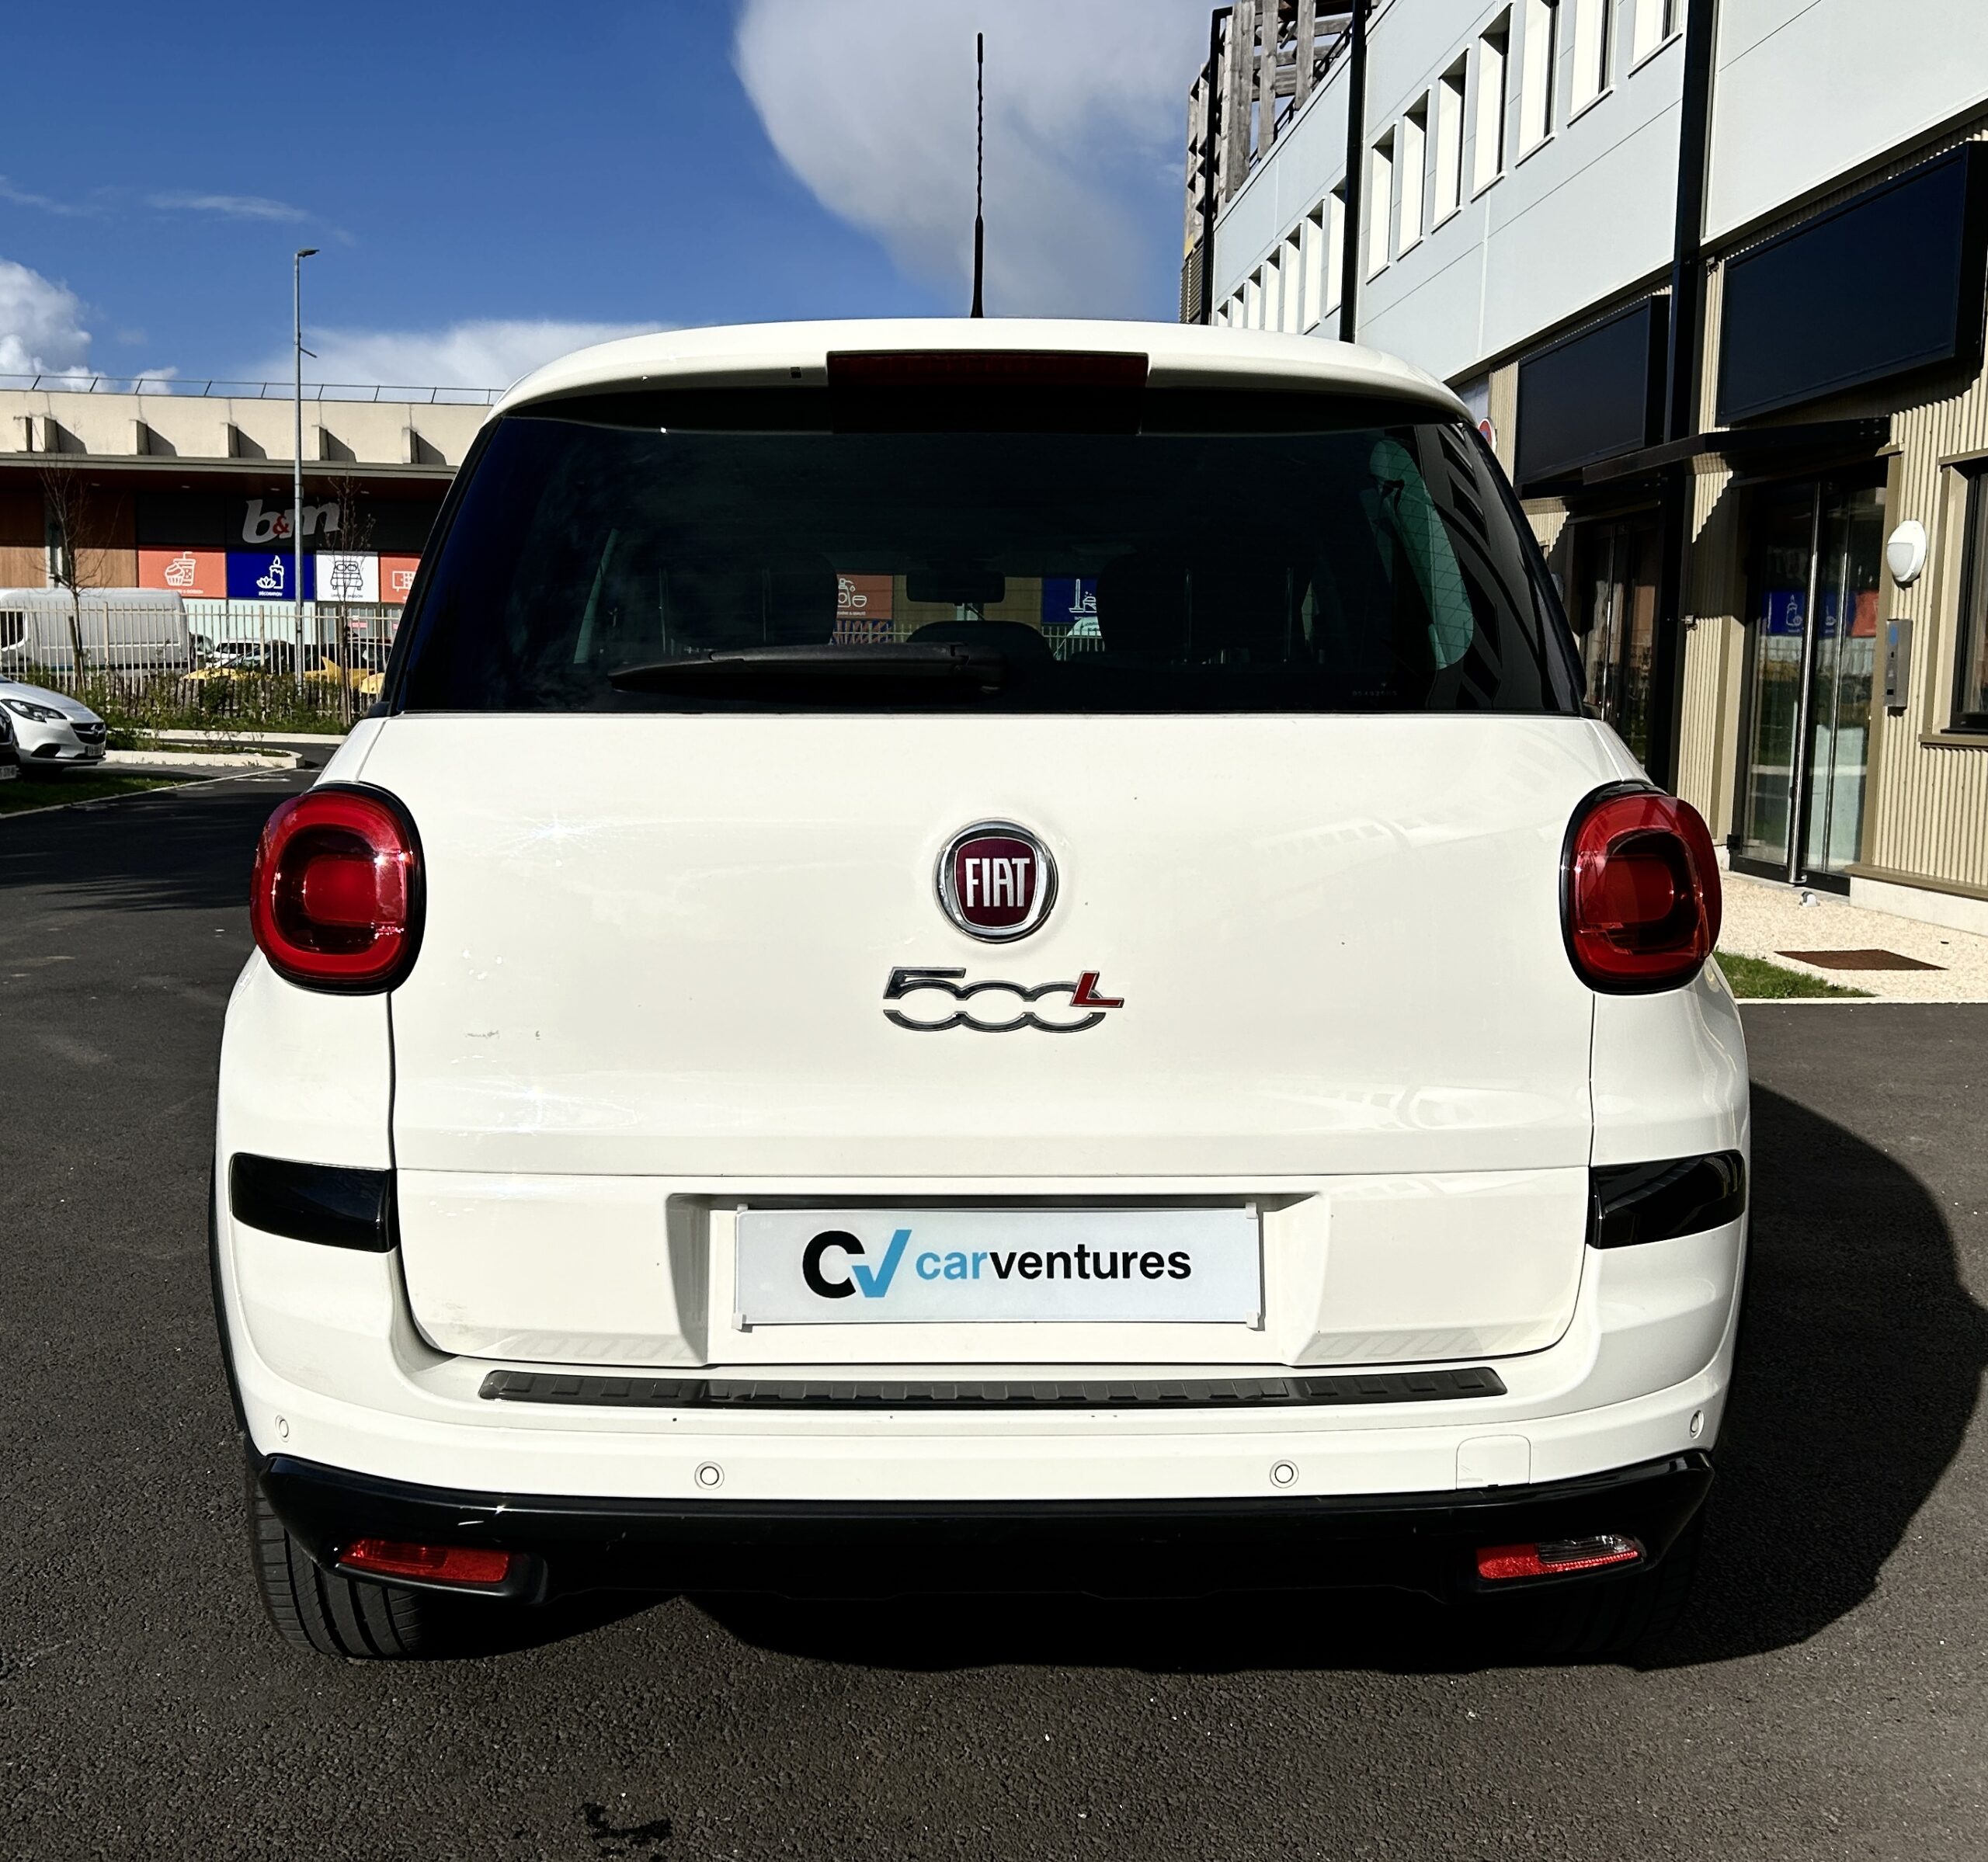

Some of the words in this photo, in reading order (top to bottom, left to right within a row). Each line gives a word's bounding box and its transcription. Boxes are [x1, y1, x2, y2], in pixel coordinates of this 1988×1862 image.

[242, 499, 341, 544] b&m
[965, 857, 1030, 908] FIAT
[883, 966, 1124, 1033] 500L
[915, 1243, 1192, 1280] carventures
